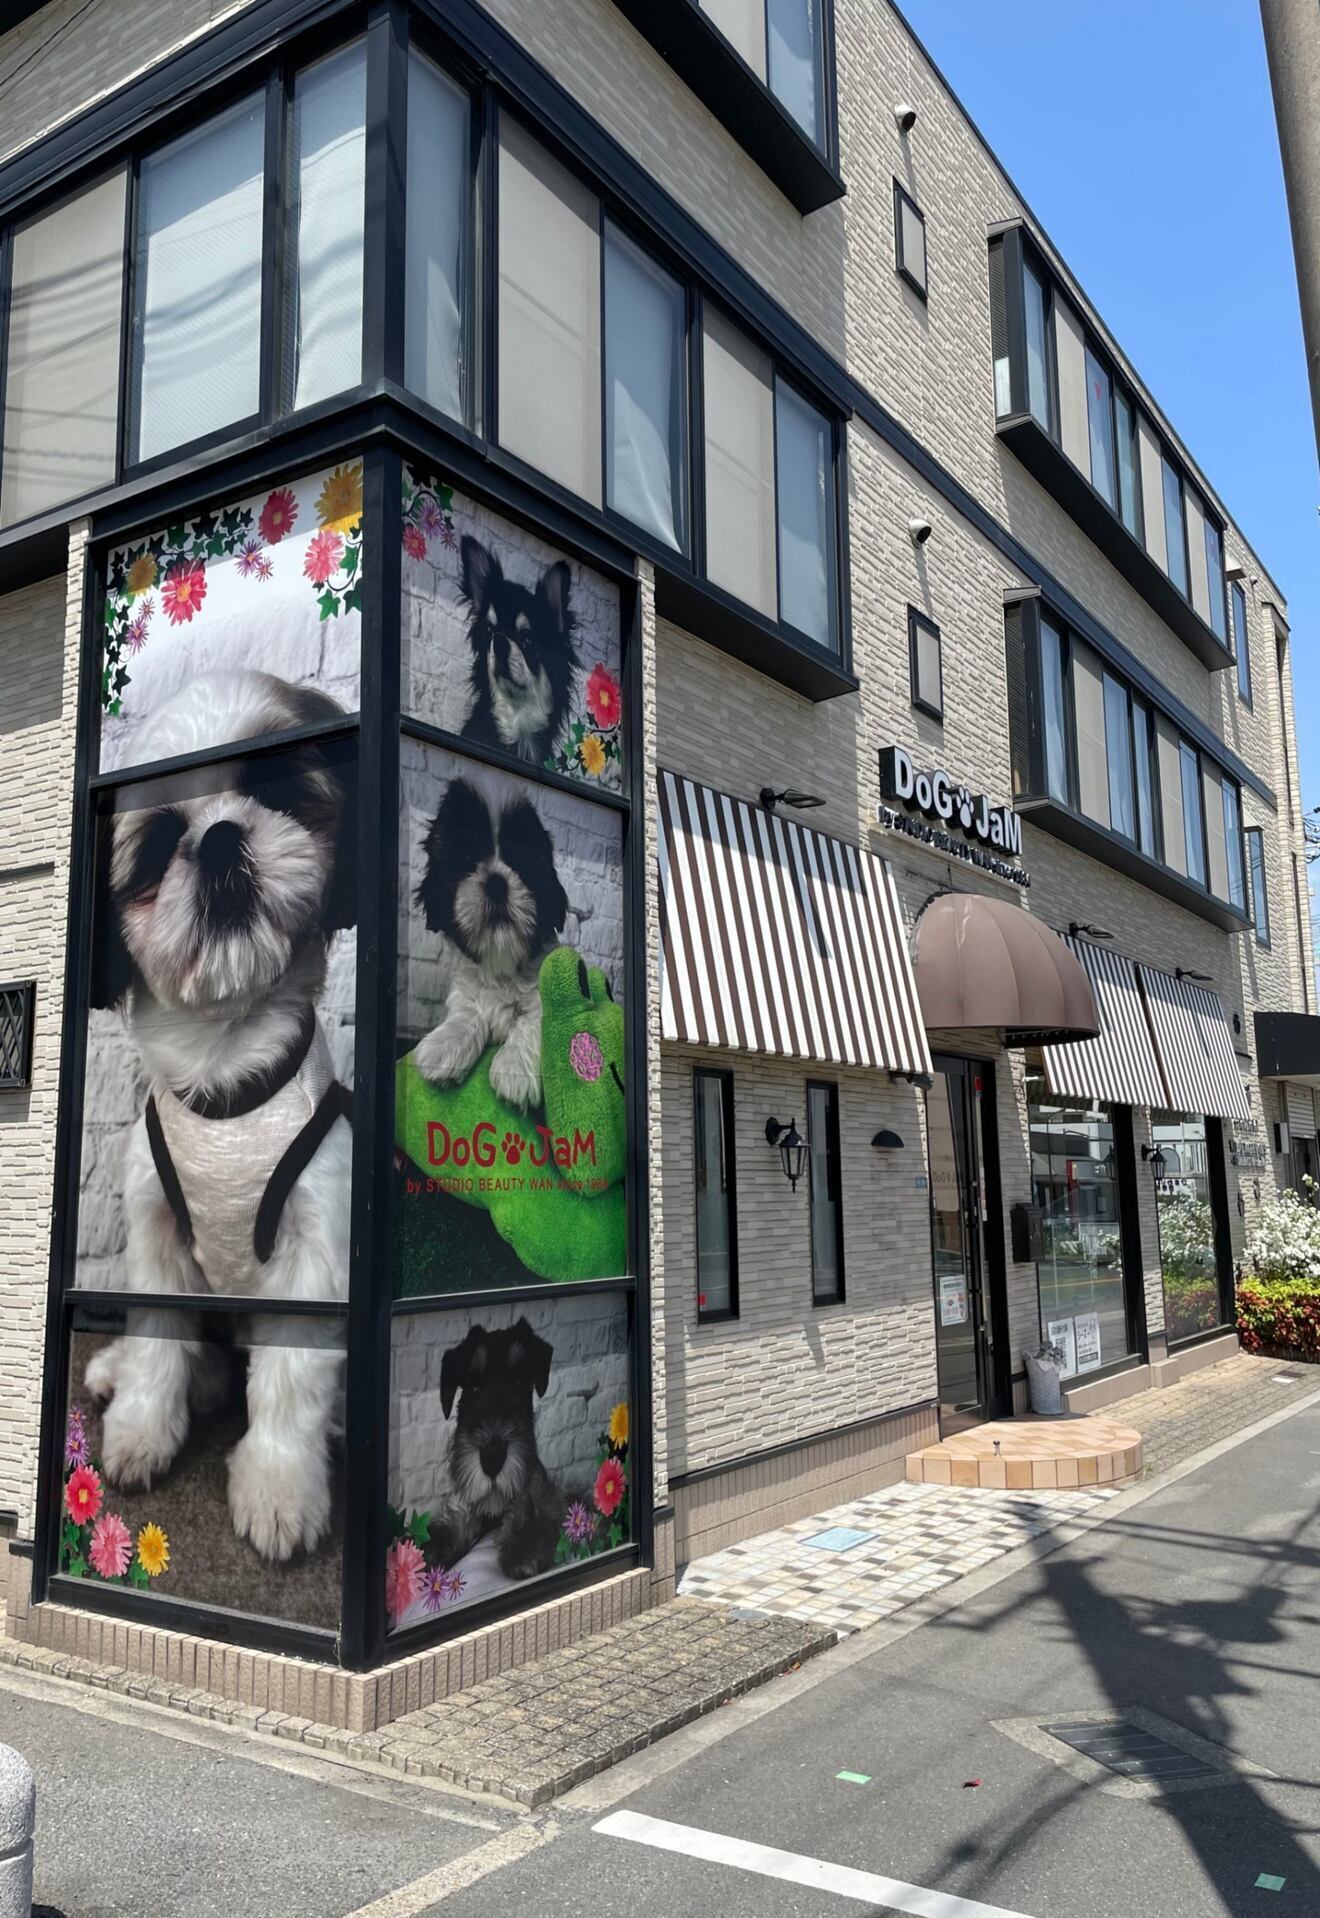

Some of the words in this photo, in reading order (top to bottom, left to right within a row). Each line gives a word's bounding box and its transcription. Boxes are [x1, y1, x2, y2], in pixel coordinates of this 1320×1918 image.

[894, 747, 953, 819] DoG
[975, 794, 1023, 855] JaM
[427, 1121, 497, 1168] DoG
[529, 1124, 597, 1169] JaM
[406, 1178, 421, 1195] by
[426, 1177, 474, 1193] STUDIO
[479, 1177, 525, 1192] BEAUTY
[529, 1177, 552, 1192] WAN
